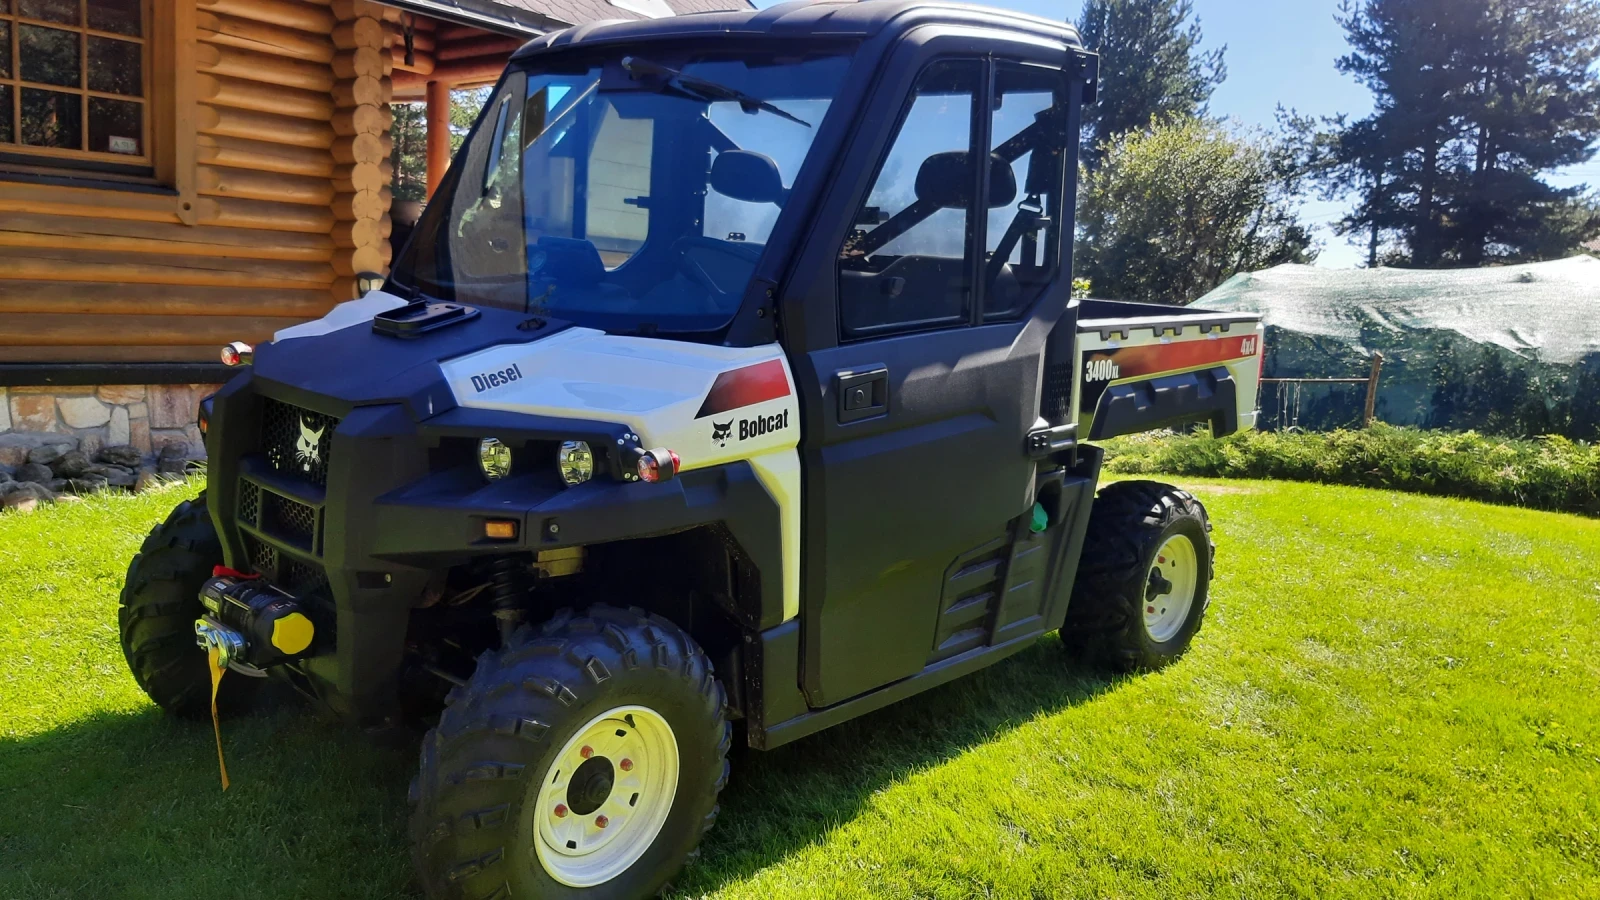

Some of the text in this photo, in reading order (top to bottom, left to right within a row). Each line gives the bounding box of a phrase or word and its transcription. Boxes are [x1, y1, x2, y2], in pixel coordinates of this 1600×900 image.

[1240, 337, 1256, 356] 4x4
[470, 362, 522, 393] Diesel
[738, 408, 789, 441] Bobcat
